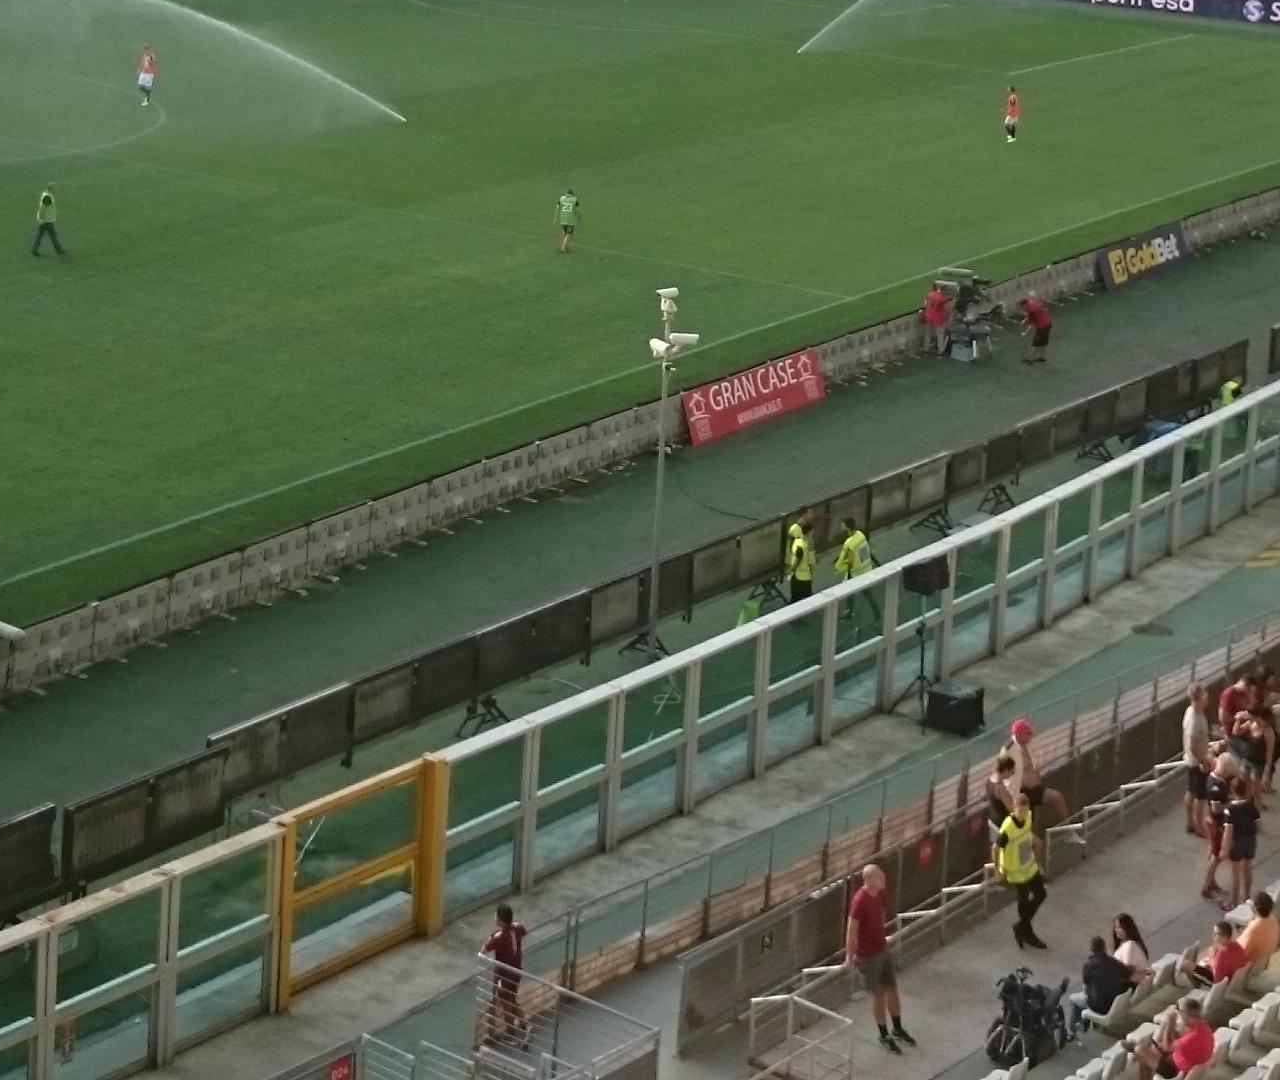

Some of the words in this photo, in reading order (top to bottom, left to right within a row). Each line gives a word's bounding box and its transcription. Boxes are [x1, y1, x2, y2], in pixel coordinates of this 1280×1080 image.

[1126, 233, 1181, 274] GoldBet
[709, 373, 756, 410] GRAN
[757, 359, 798, 394] CASE
